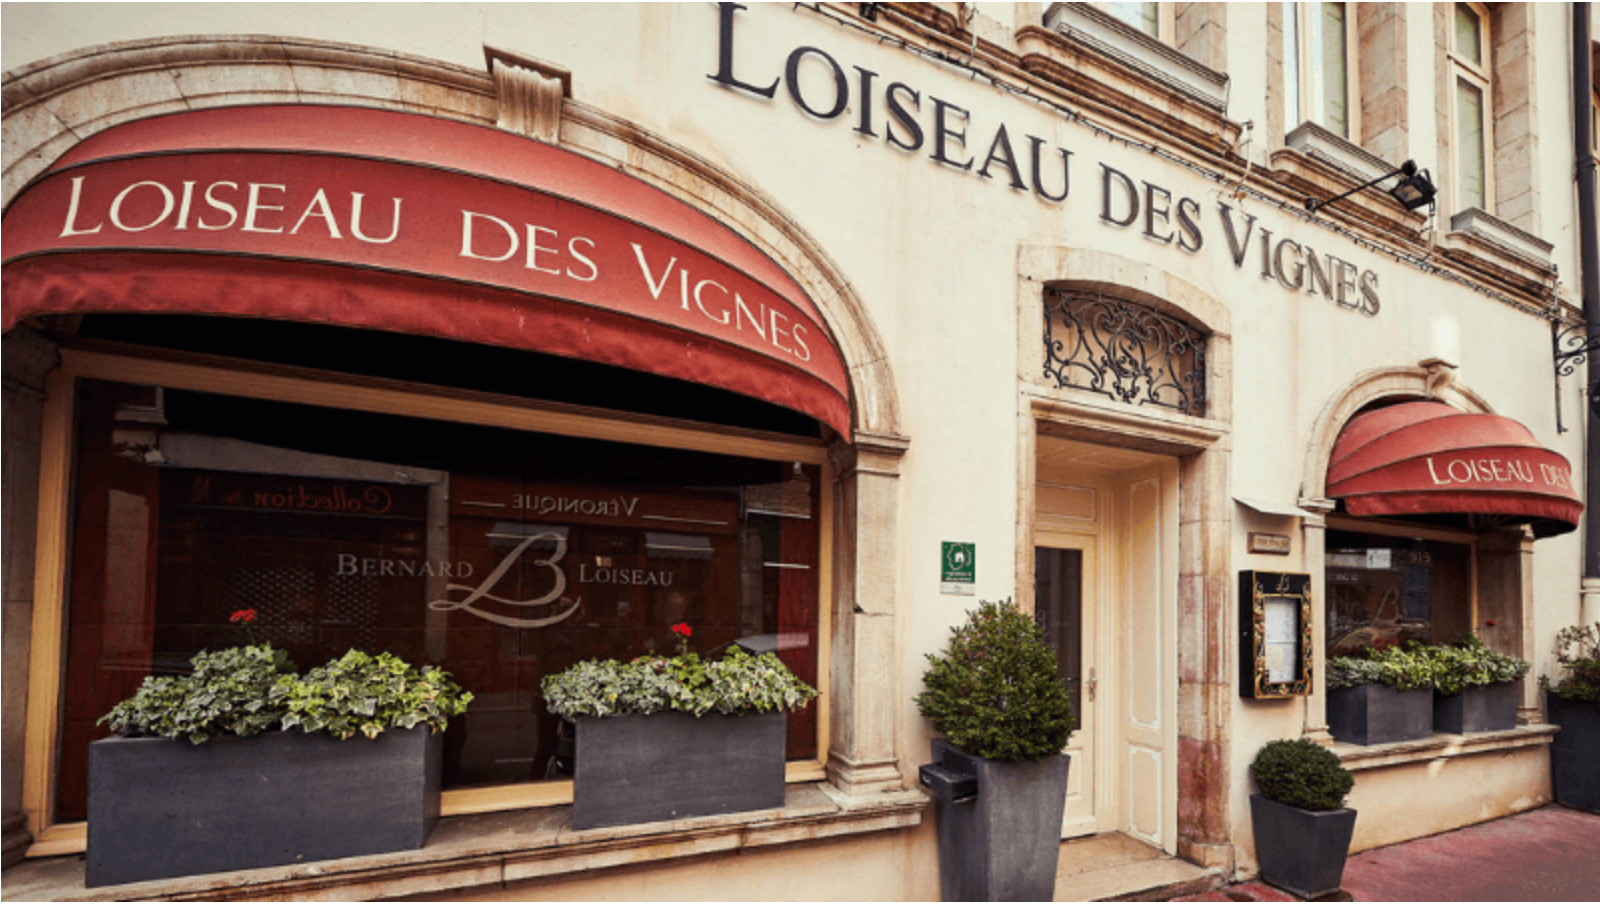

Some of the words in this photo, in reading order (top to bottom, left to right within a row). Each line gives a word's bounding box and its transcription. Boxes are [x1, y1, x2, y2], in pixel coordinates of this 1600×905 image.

[706, 2, 1074, 202] LOISEAU
[1099, 162, 1204, 254] DES
[1217, 201, 1381, 318] VIGNES
[59, 176, 404, 244] LOISEAU
[460, 209, 600, 283] DES
[631, 243, 812, 363] VIGNES
[1425, 457, 1534, 485] LOISEAU
[336, 553, 474, 579] BERNARD
[579, 563, 674, 587] LOISEAU
